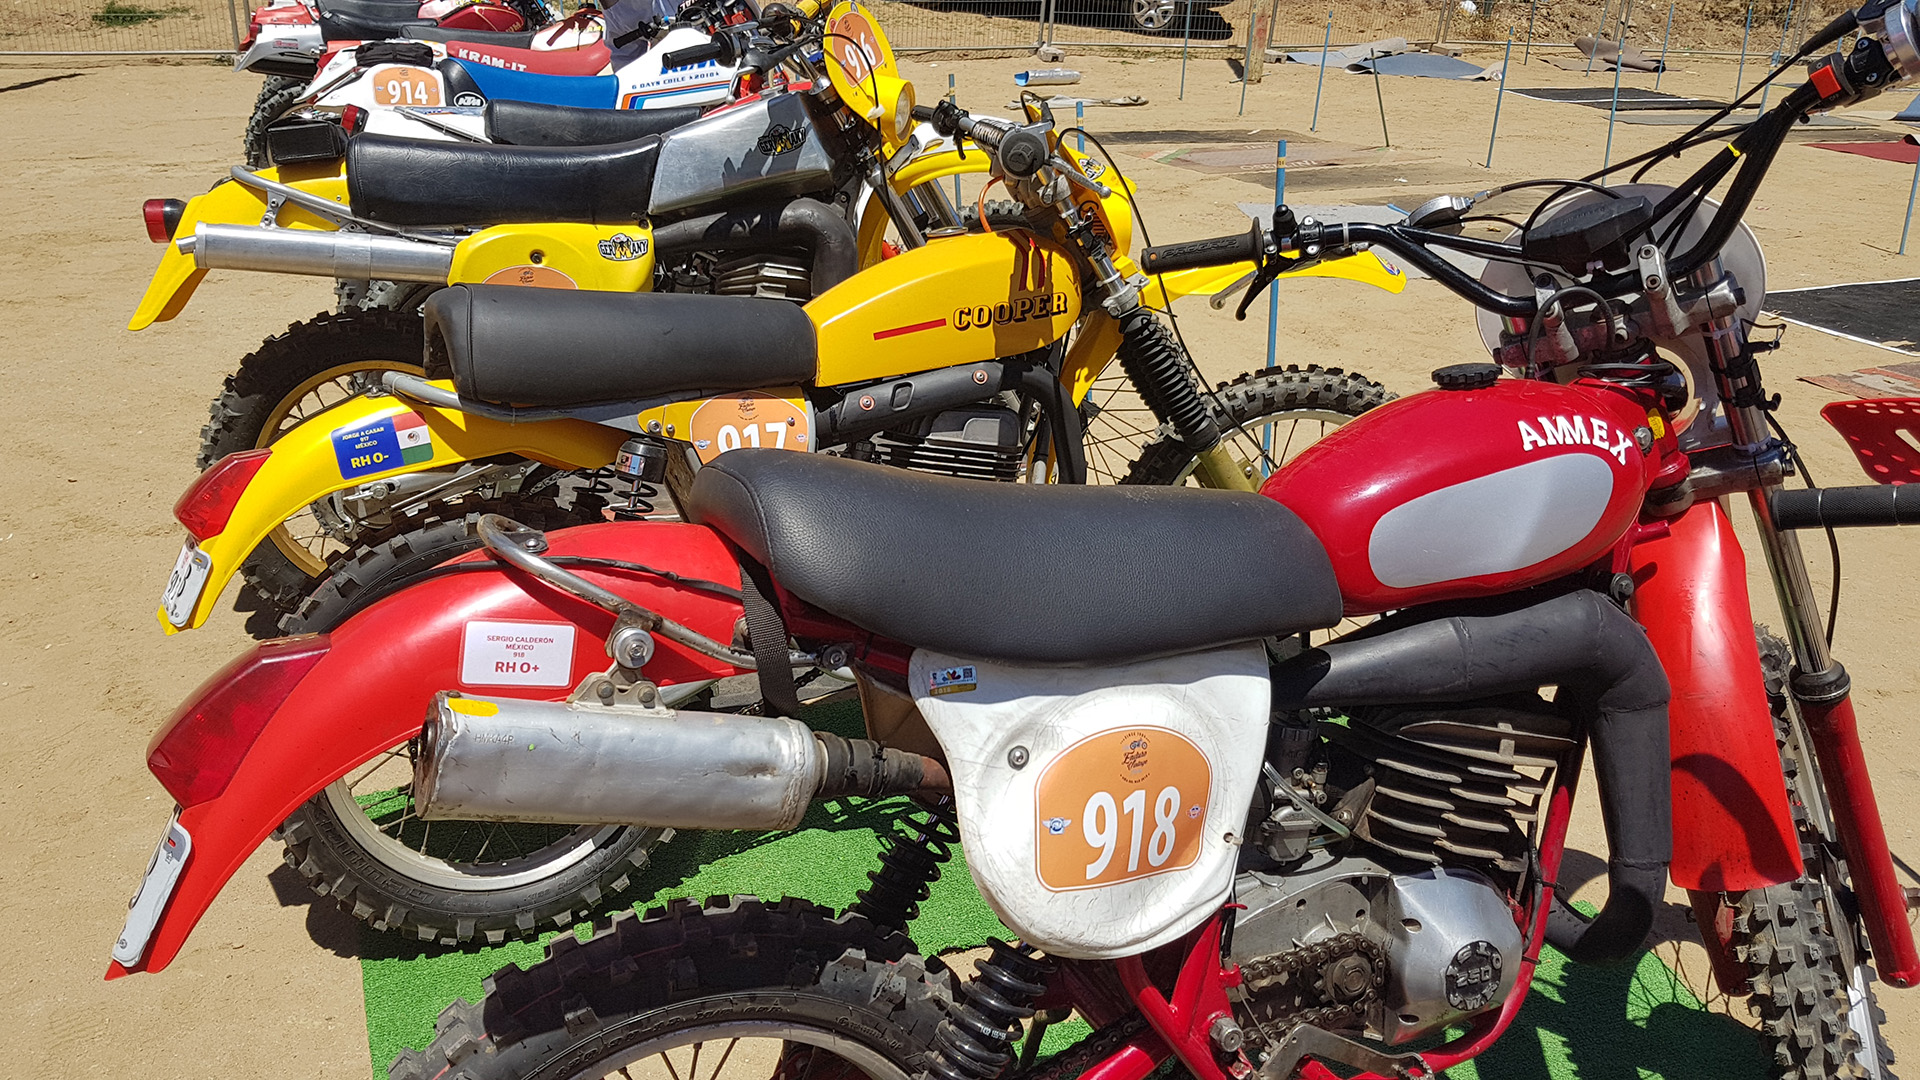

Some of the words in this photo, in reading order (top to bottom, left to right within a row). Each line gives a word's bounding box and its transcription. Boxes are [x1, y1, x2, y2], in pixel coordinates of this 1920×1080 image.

[458, 48, 527, 73] KRAM-IT
[663, 76, 686, 85] CHILE
[387, 80, 428, 105] 914
[599, 239, 648, 259] GERMANY
[953, 292, 1068, 331] COOPER
[342, 432, 360, 441] JORGE
[1517, 415, 1633, 466] AMMEX
[350, 455, 371, 469] RH
[372, 452, 390, 463] O-
[487, 635, 514, 643] SERGIO
[505, 643, 535, 651] MÉXICO
[495, 661, 517, 673] RH
[519, 662, 540, 674] O+
[1082, 786, 1181, 881] 918
[1456, 964, 1493, 988] 250
